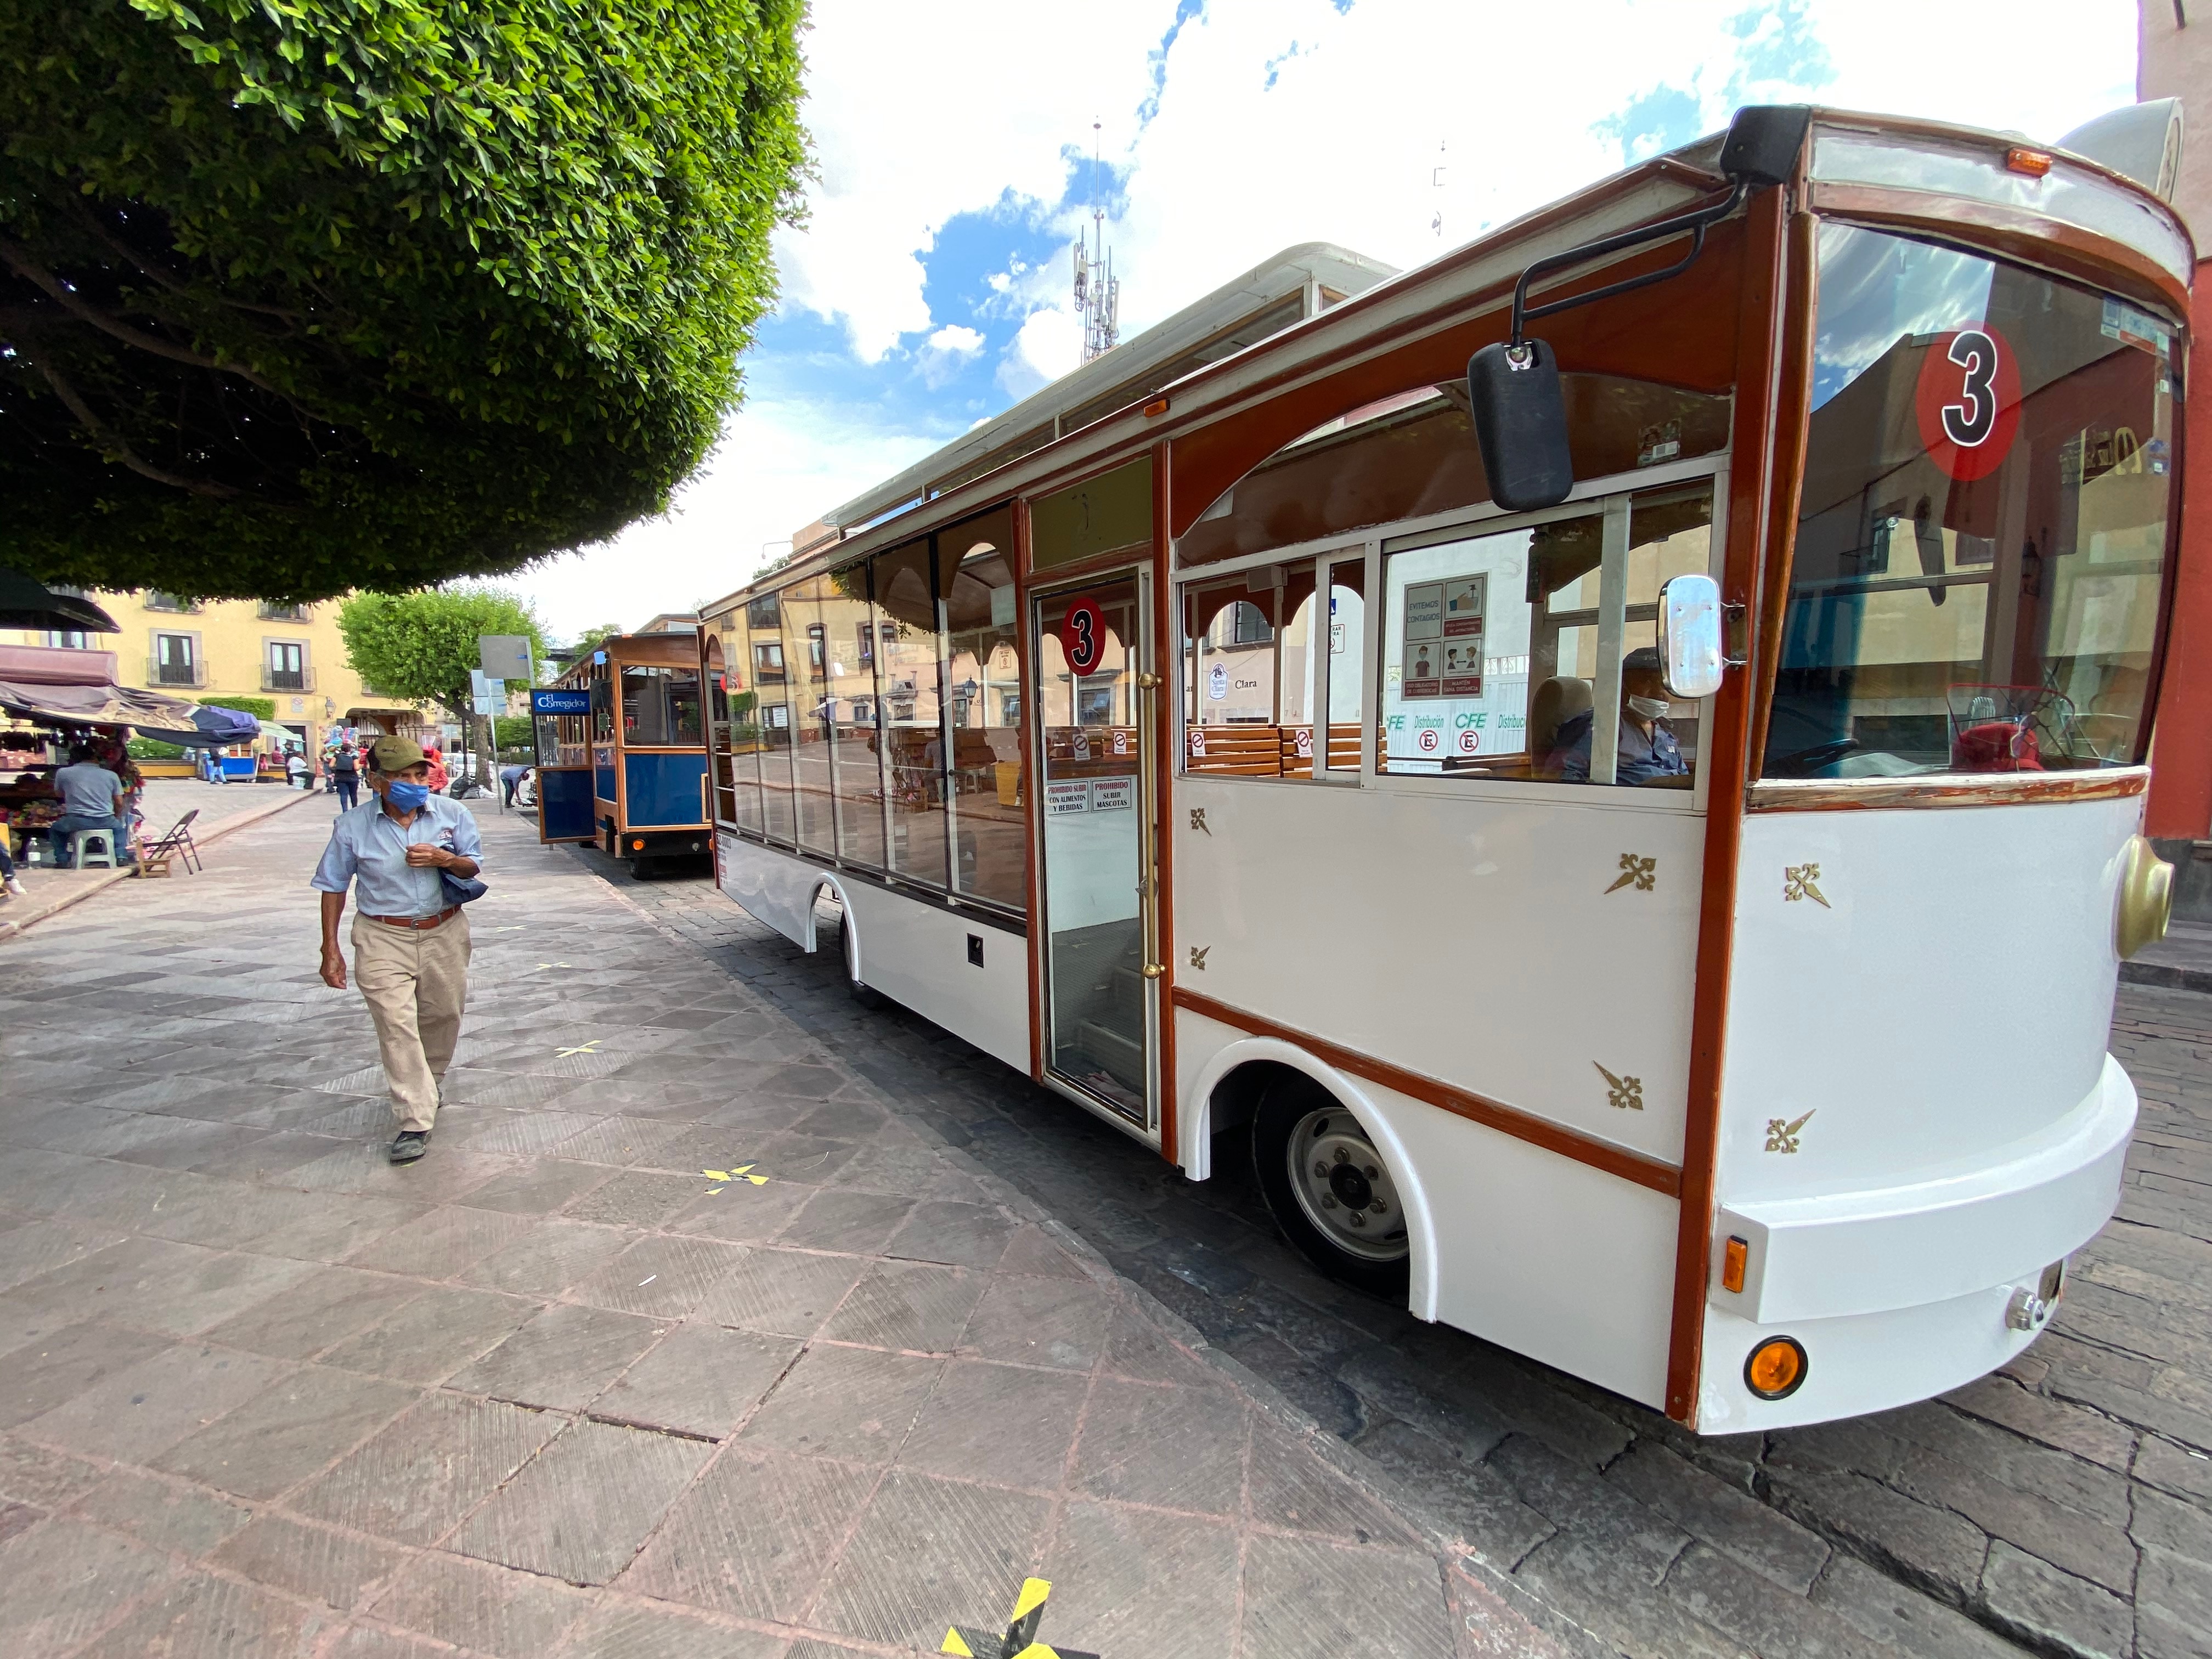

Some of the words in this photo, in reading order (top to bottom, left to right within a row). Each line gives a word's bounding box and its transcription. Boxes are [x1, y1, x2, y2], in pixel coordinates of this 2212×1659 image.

[1941, 330, 1997, 447] 3
[1409, 600, 1438, 611] EVITEMOS
[1407, 613, 1440, 623] CONTAGIOS
[1071, 609, 1094, 667] 3
[1235, 680, 1257, 689] Clara
[546, 693, 553, 702] El
[538, 697, 586, 709] Corregidor
[1414, 715, 1444, 729] Distribución
[1455, 713, 1487, 729] CFE
[1048, 786, 1073, 794] PROHIBIDO
[1095, 781, 1128, 791] PROHIBIDO
[1060, 794, 1086, 803] ALIMENTOS
[1097, 799, 1127, 808] MASCOTAS
[1059, 803, 1083, 812] BEBIDAS
